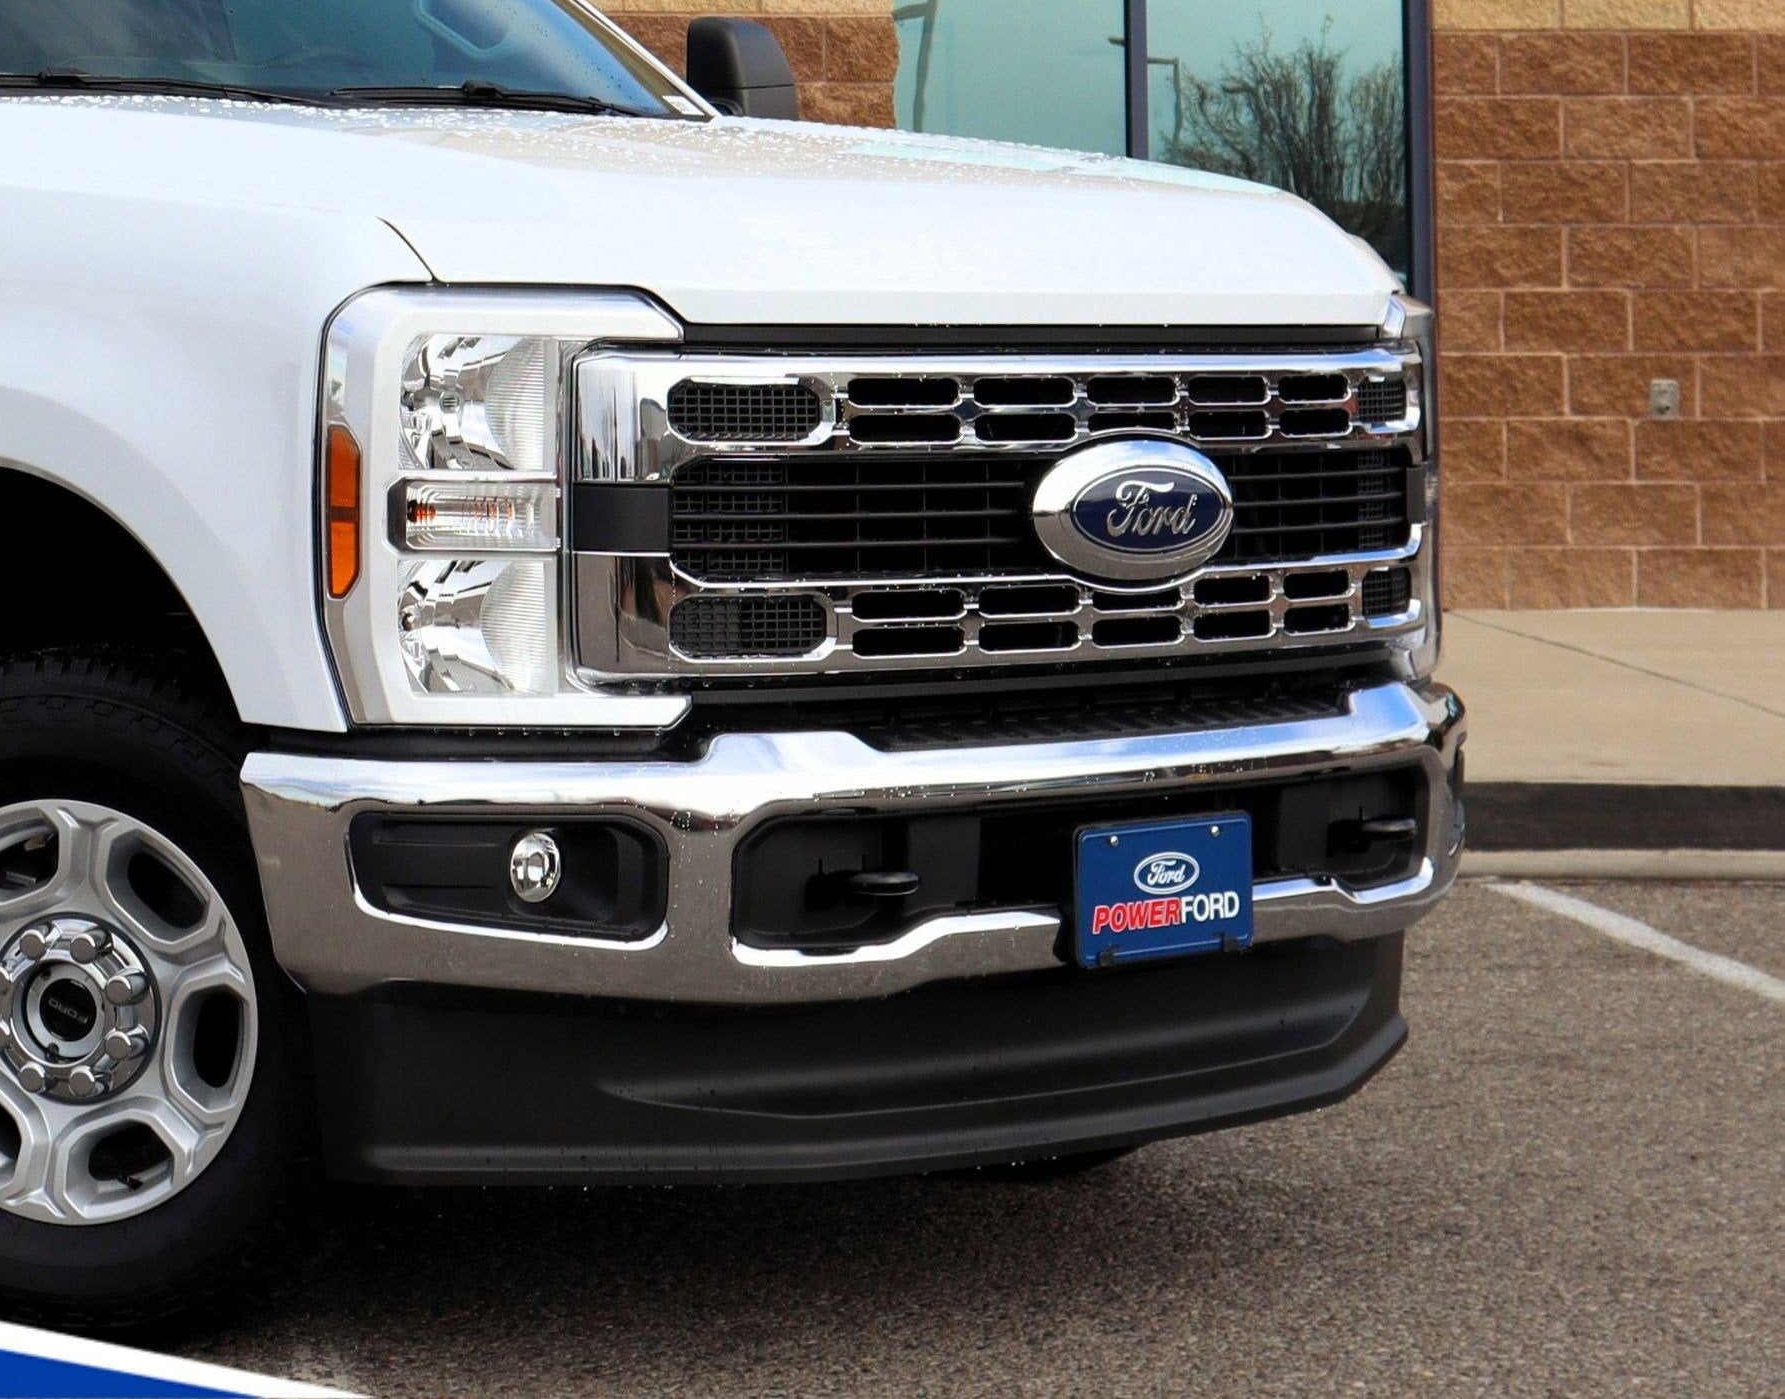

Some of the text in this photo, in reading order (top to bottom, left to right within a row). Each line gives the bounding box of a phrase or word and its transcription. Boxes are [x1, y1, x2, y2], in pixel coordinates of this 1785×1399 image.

[1106, 480, 1198, 537] Ford
[1147, 860, 1186, 886] Ford
[1092, 891, 1240, 934] POWERFORD
